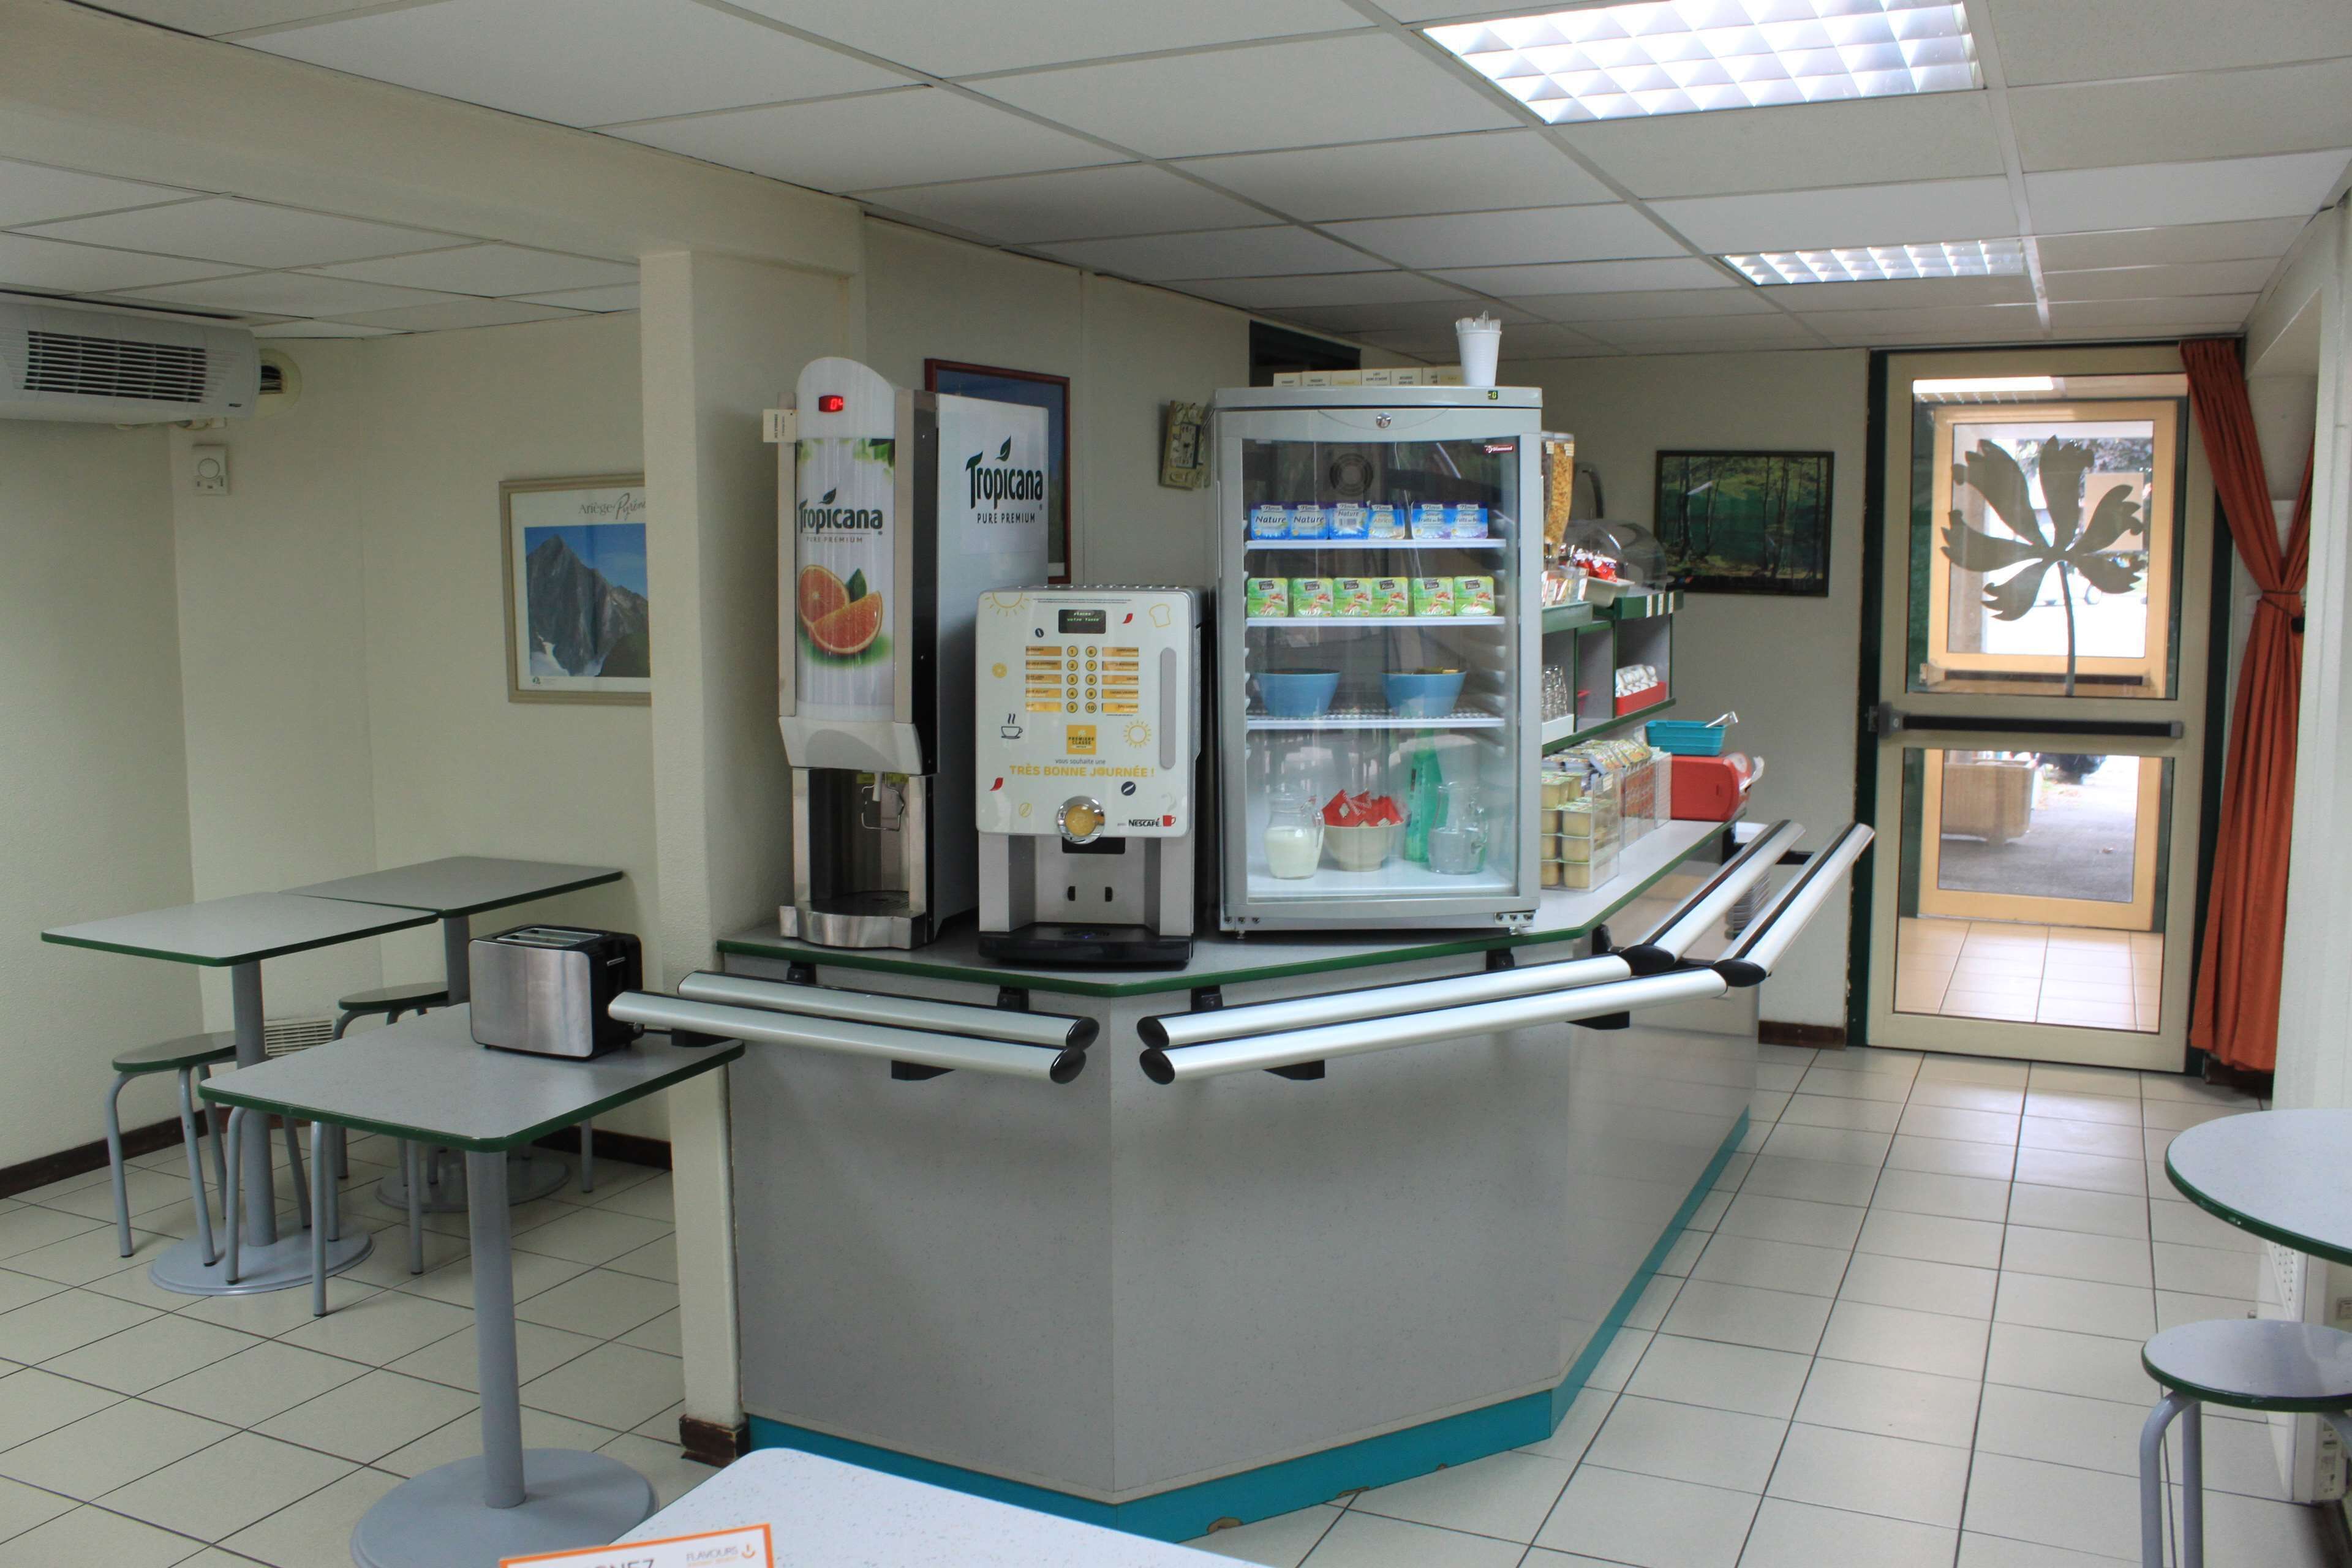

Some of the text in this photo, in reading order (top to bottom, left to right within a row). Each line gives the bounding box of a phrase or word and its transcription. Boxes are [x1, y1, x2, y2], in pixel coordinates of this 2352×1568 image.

[965, 451, 1043, 510] Tropicana
[578, 502, 613, 515] Ariège
[799, 499, 883, 534] Tropicana
[978, 513, 1035, 524] PURE PREMIUM
[1009, 763, 1040, 775] TRÈS
[1044, 766, 1087, 777] BONNE
[1090, 765, 1147, 777] JOURNÉE
[1129, 818, 1161, 827] NESCAFÉ
[686, 1547, 737, 1561] FLAVOURS
